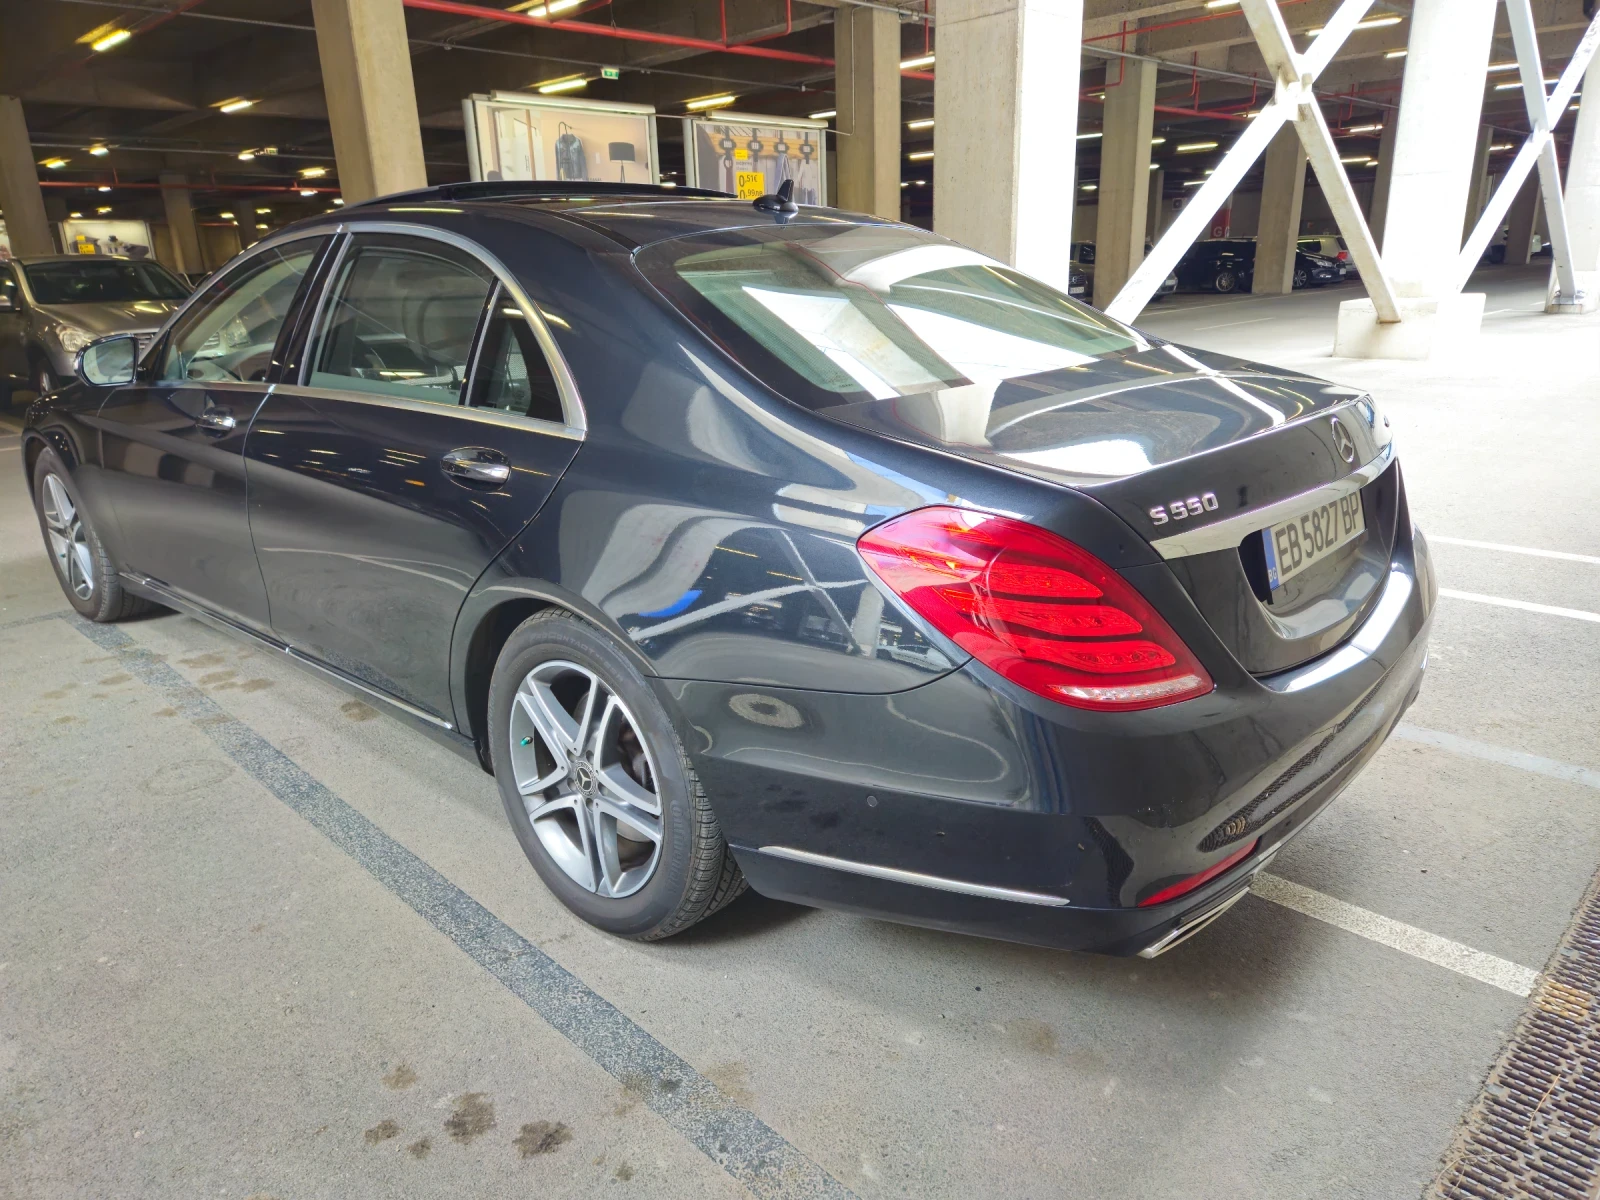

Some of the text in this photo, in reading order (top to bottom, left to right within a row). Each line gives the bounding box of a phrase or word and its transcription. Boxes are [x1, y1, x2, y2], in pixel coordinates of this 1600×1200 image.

[1149, 492, 1219, 526] S 550
[1268, 567, 1278, 582] BG
